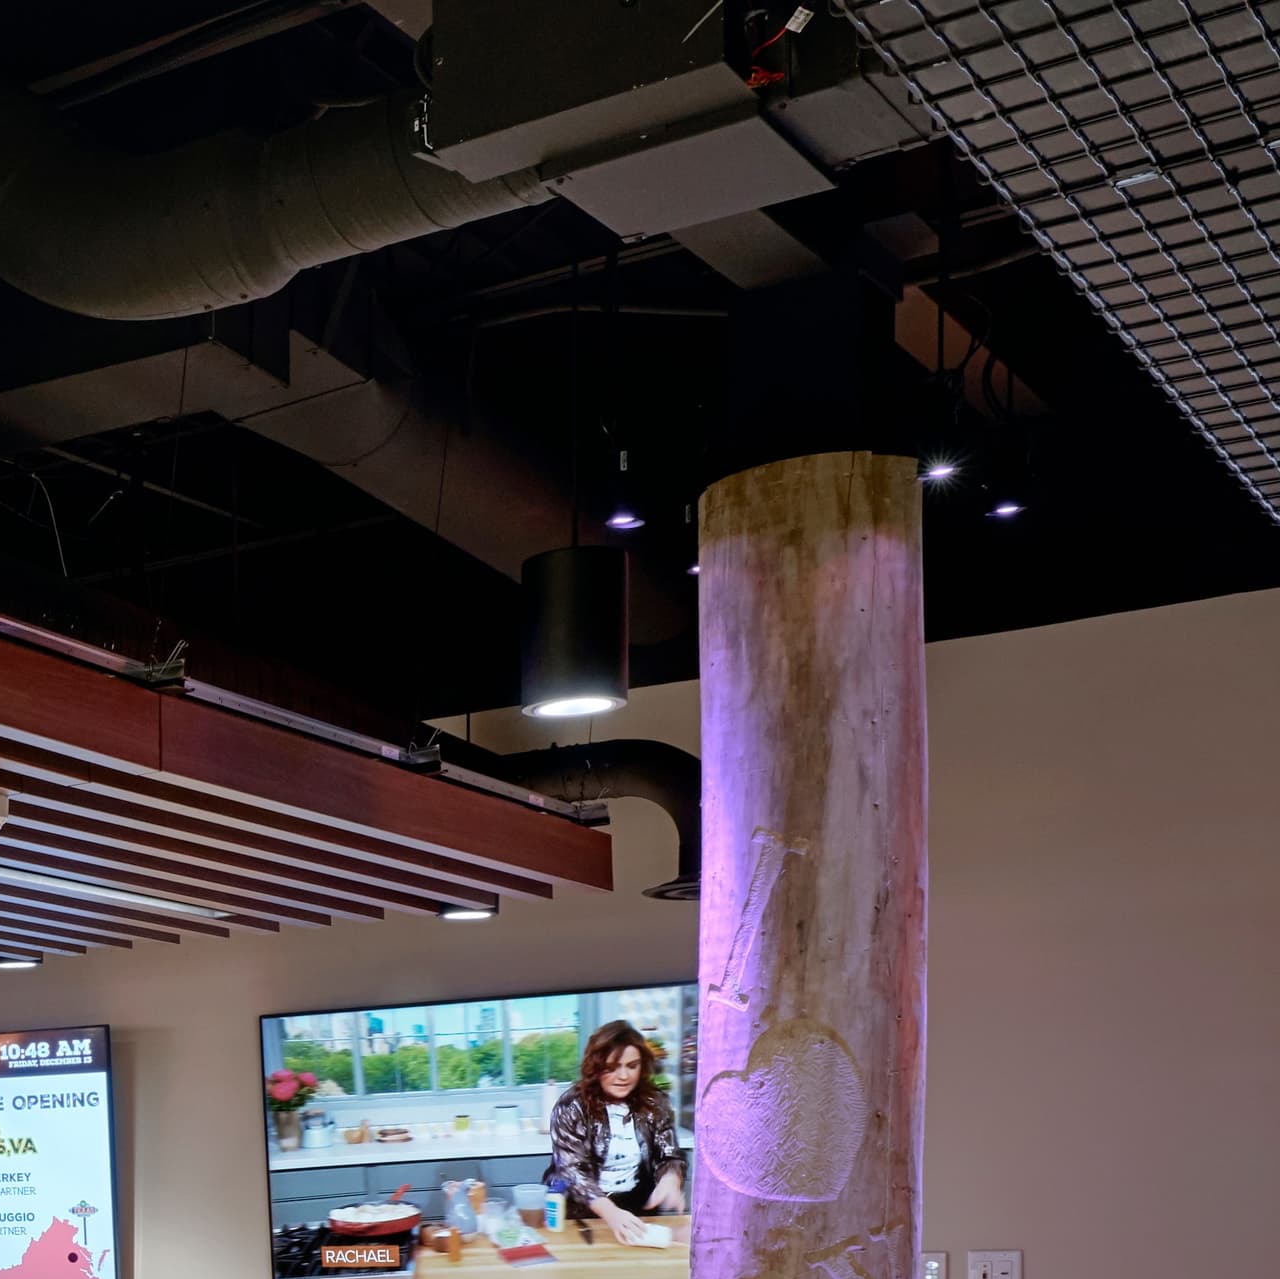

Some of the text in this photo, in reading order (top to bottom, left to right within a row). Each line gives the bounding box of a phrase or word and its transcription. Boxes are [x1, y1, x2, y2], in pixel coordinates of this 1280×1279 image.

[0, 1039, 92, 1061] 10:48 AM
[40, 1058, 82, 1067] DECEMBER
[12, 1091, 100, 1111] OPENING
[325, 1249, 395, 1265] RACHAEL
